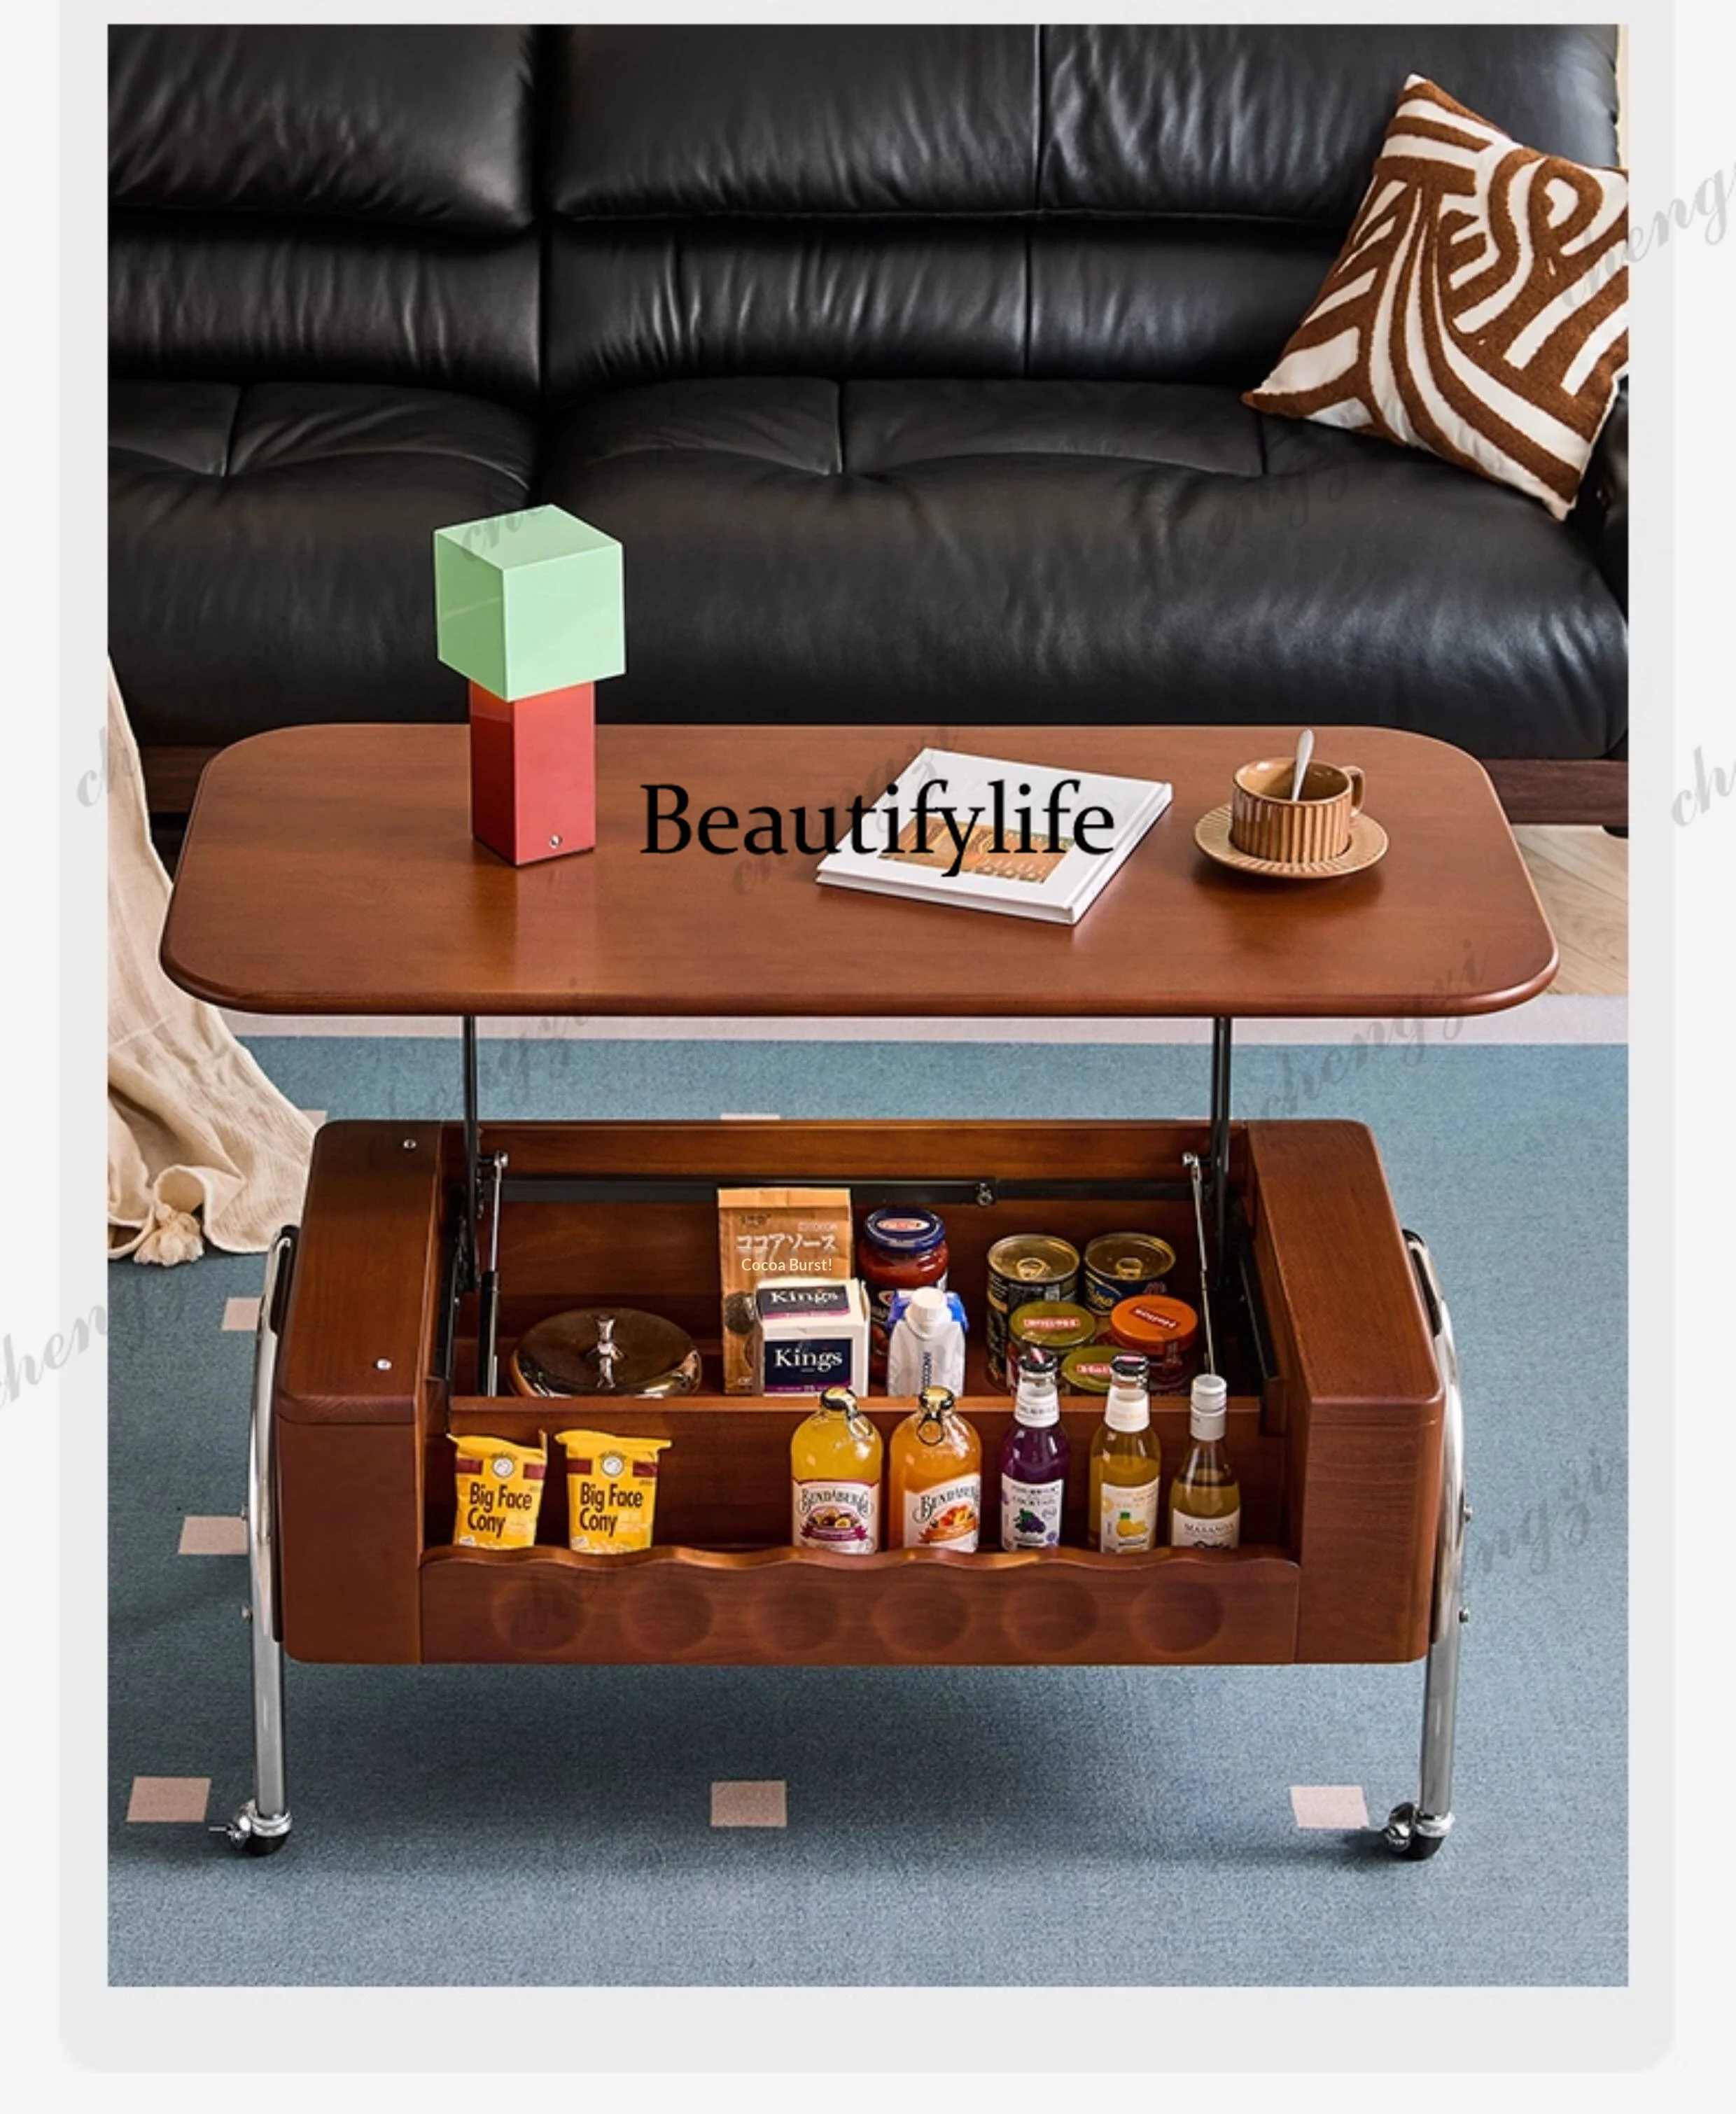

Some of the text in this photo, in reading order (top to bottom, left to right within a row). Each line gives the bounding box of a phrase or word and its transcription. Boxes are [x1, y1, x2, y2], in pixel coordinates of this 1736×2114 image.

[736, 1233, 836, 1251] ココアソース
[741, 1258, 832, 1271] Cocoa Burst!
[774, 1348, 843, 1373] Kings
[470, 1481, 533, 1513] Big Face
[580, 1480, 643, 1513] Big Face
[467, 1507, 505, 1538] Cony
[579, 1507, 619, 1536] Cony
